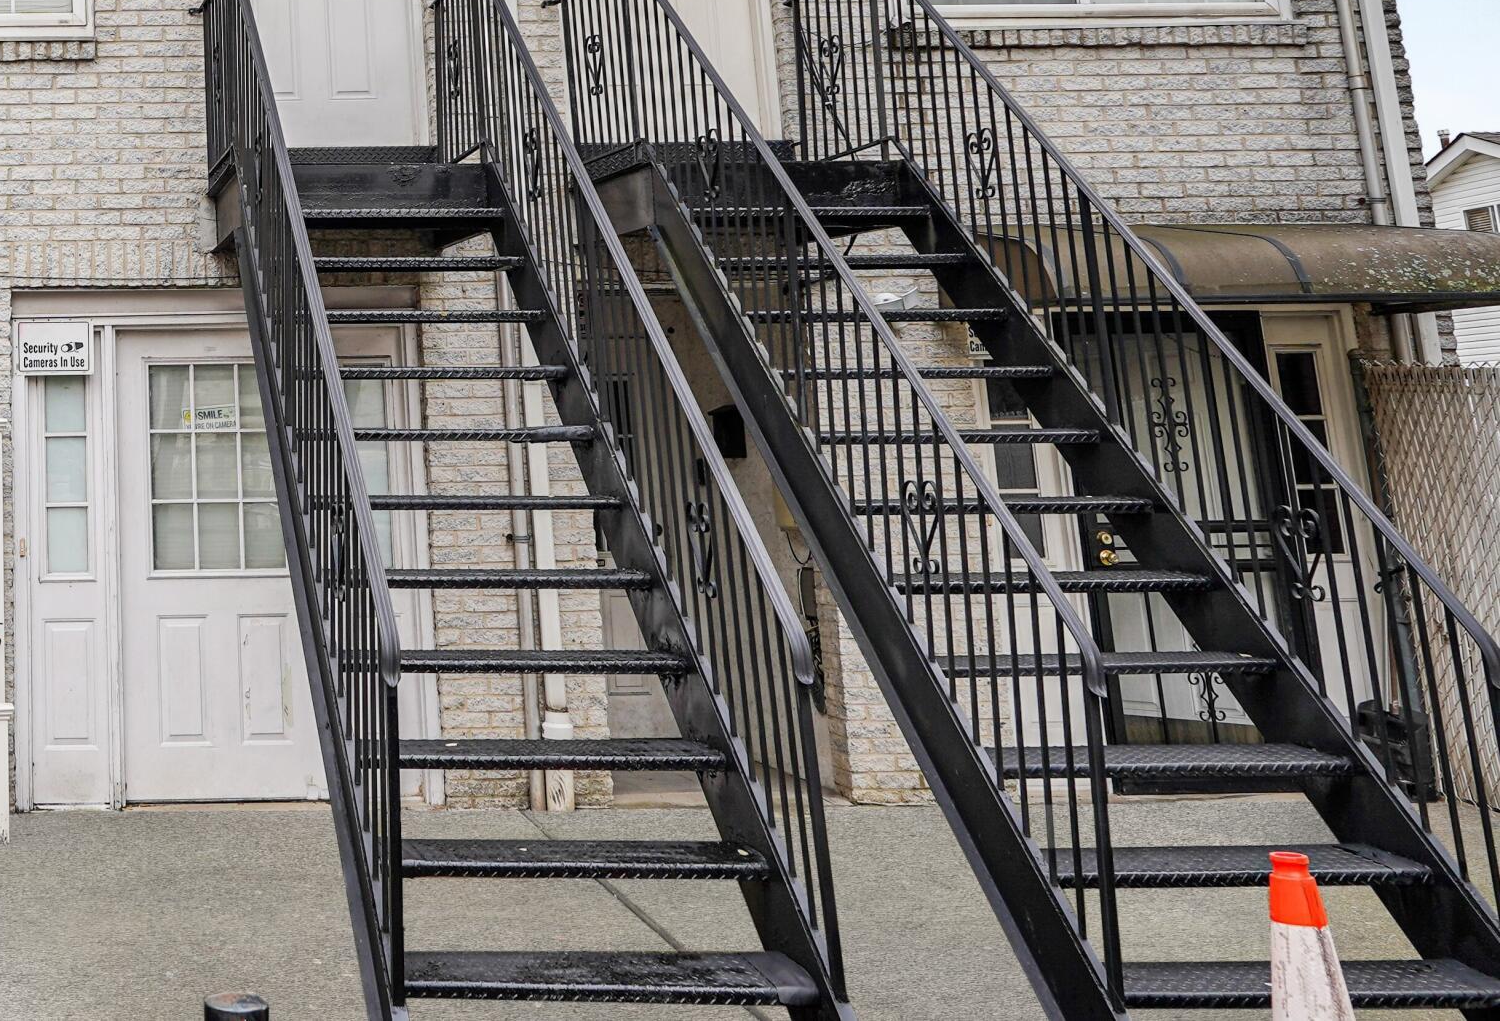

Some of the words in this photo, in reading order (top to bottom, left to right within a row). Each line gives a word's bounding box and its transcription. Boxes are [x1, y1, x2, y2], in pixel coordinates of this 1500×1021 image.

[23, 342, 58, 355] Security
[23, 356, 58, 368] Cameras
[60, 356, 68, 367] In
[70, 356, 85, 368] Use
[197, 409, 223, 420] SMILE
